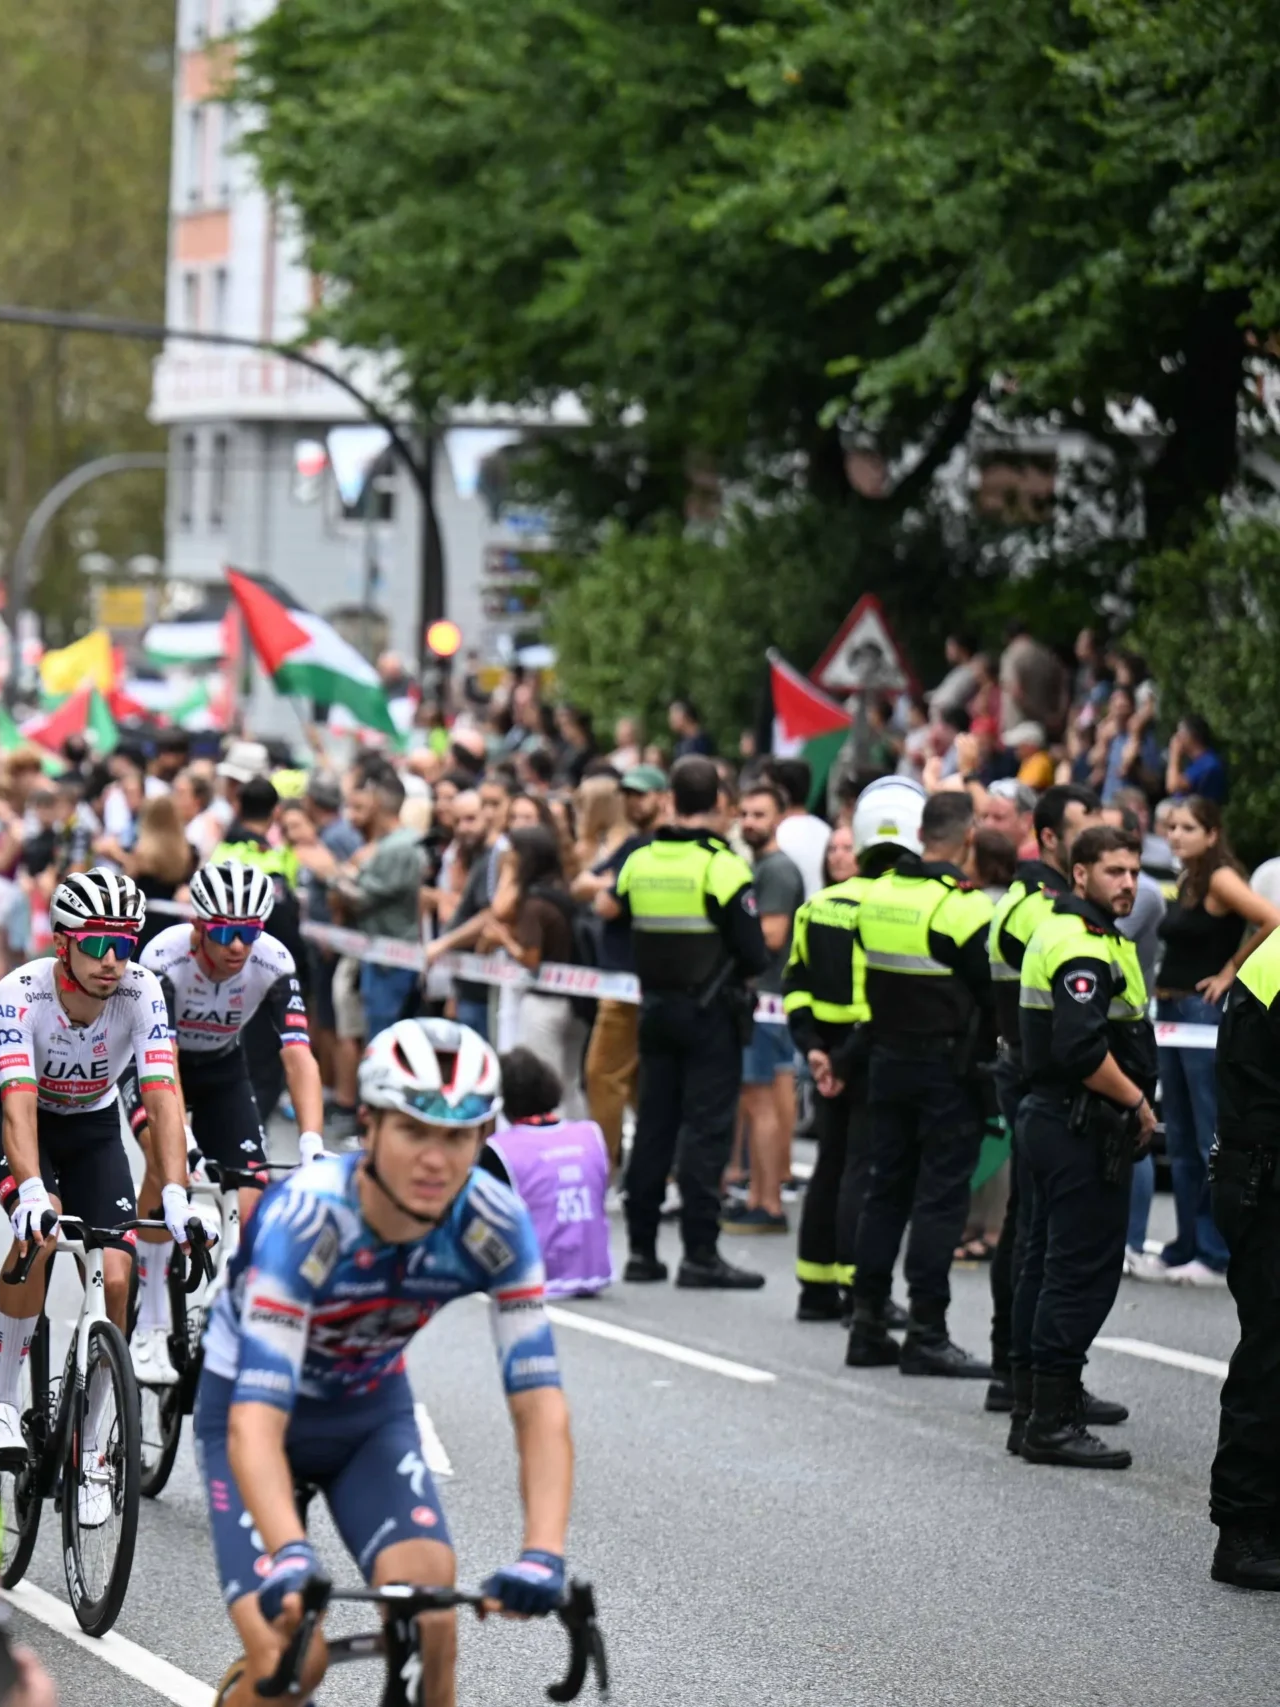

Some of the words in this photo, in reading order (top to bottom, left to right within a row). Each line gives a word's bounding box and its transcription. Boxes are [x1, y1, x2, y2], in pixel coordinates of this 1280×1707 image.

[62, 888, 85, 909] MET
[151, 1000, 166, 1014] FA
[181, 1009, 243, 1025] UAE
[43, 1059, 109, 1080] UAE
